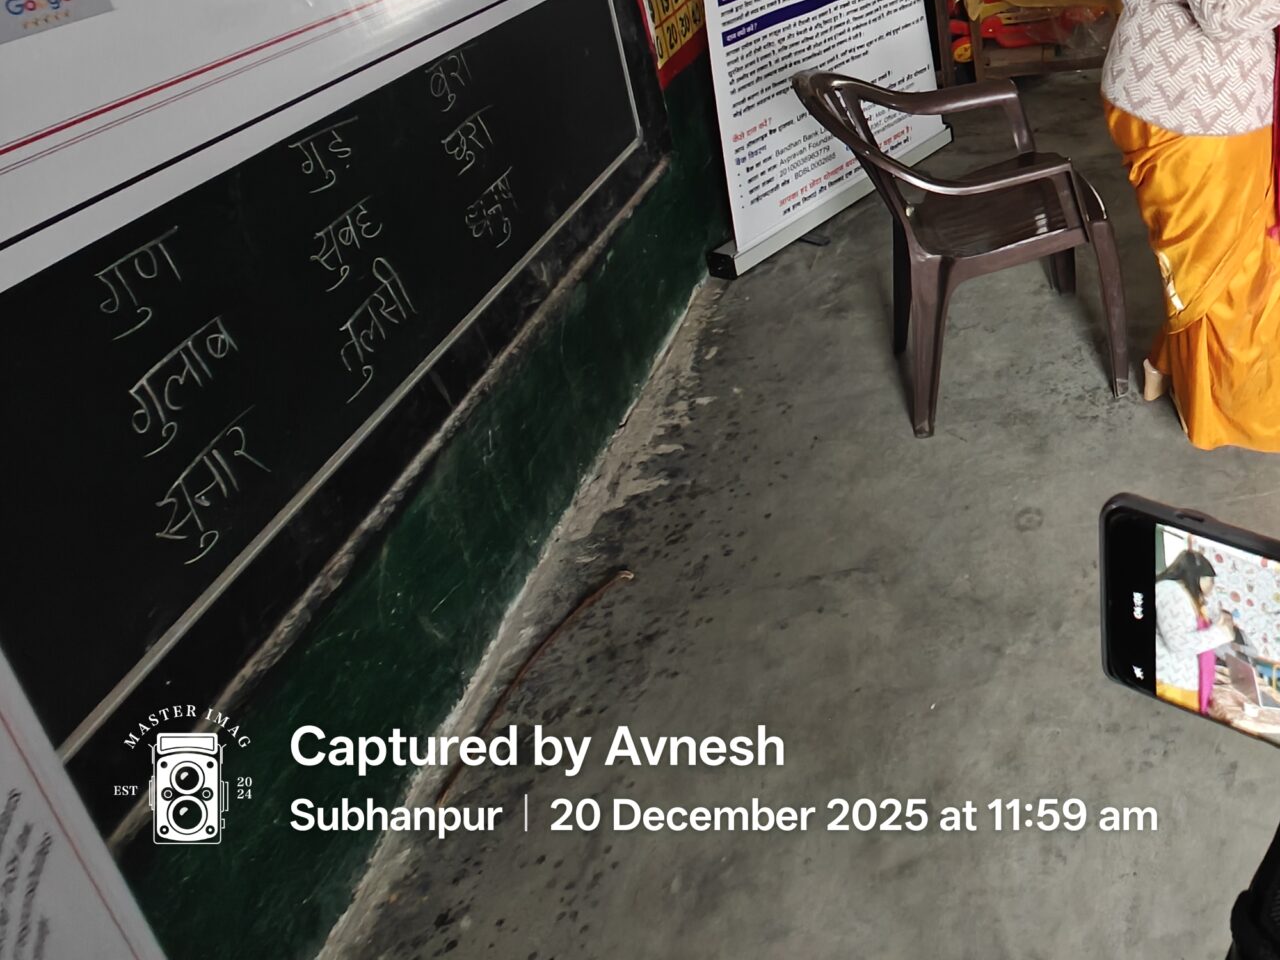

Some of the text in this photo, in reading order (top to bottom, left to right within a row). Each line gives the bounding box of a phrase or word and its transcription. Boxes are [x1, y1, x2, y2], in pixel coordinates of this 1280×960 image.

[666, 23, 678, 50] 20
[94, 224, 182, 341] गुण
[128, 315, 238, 458] गुलाब
